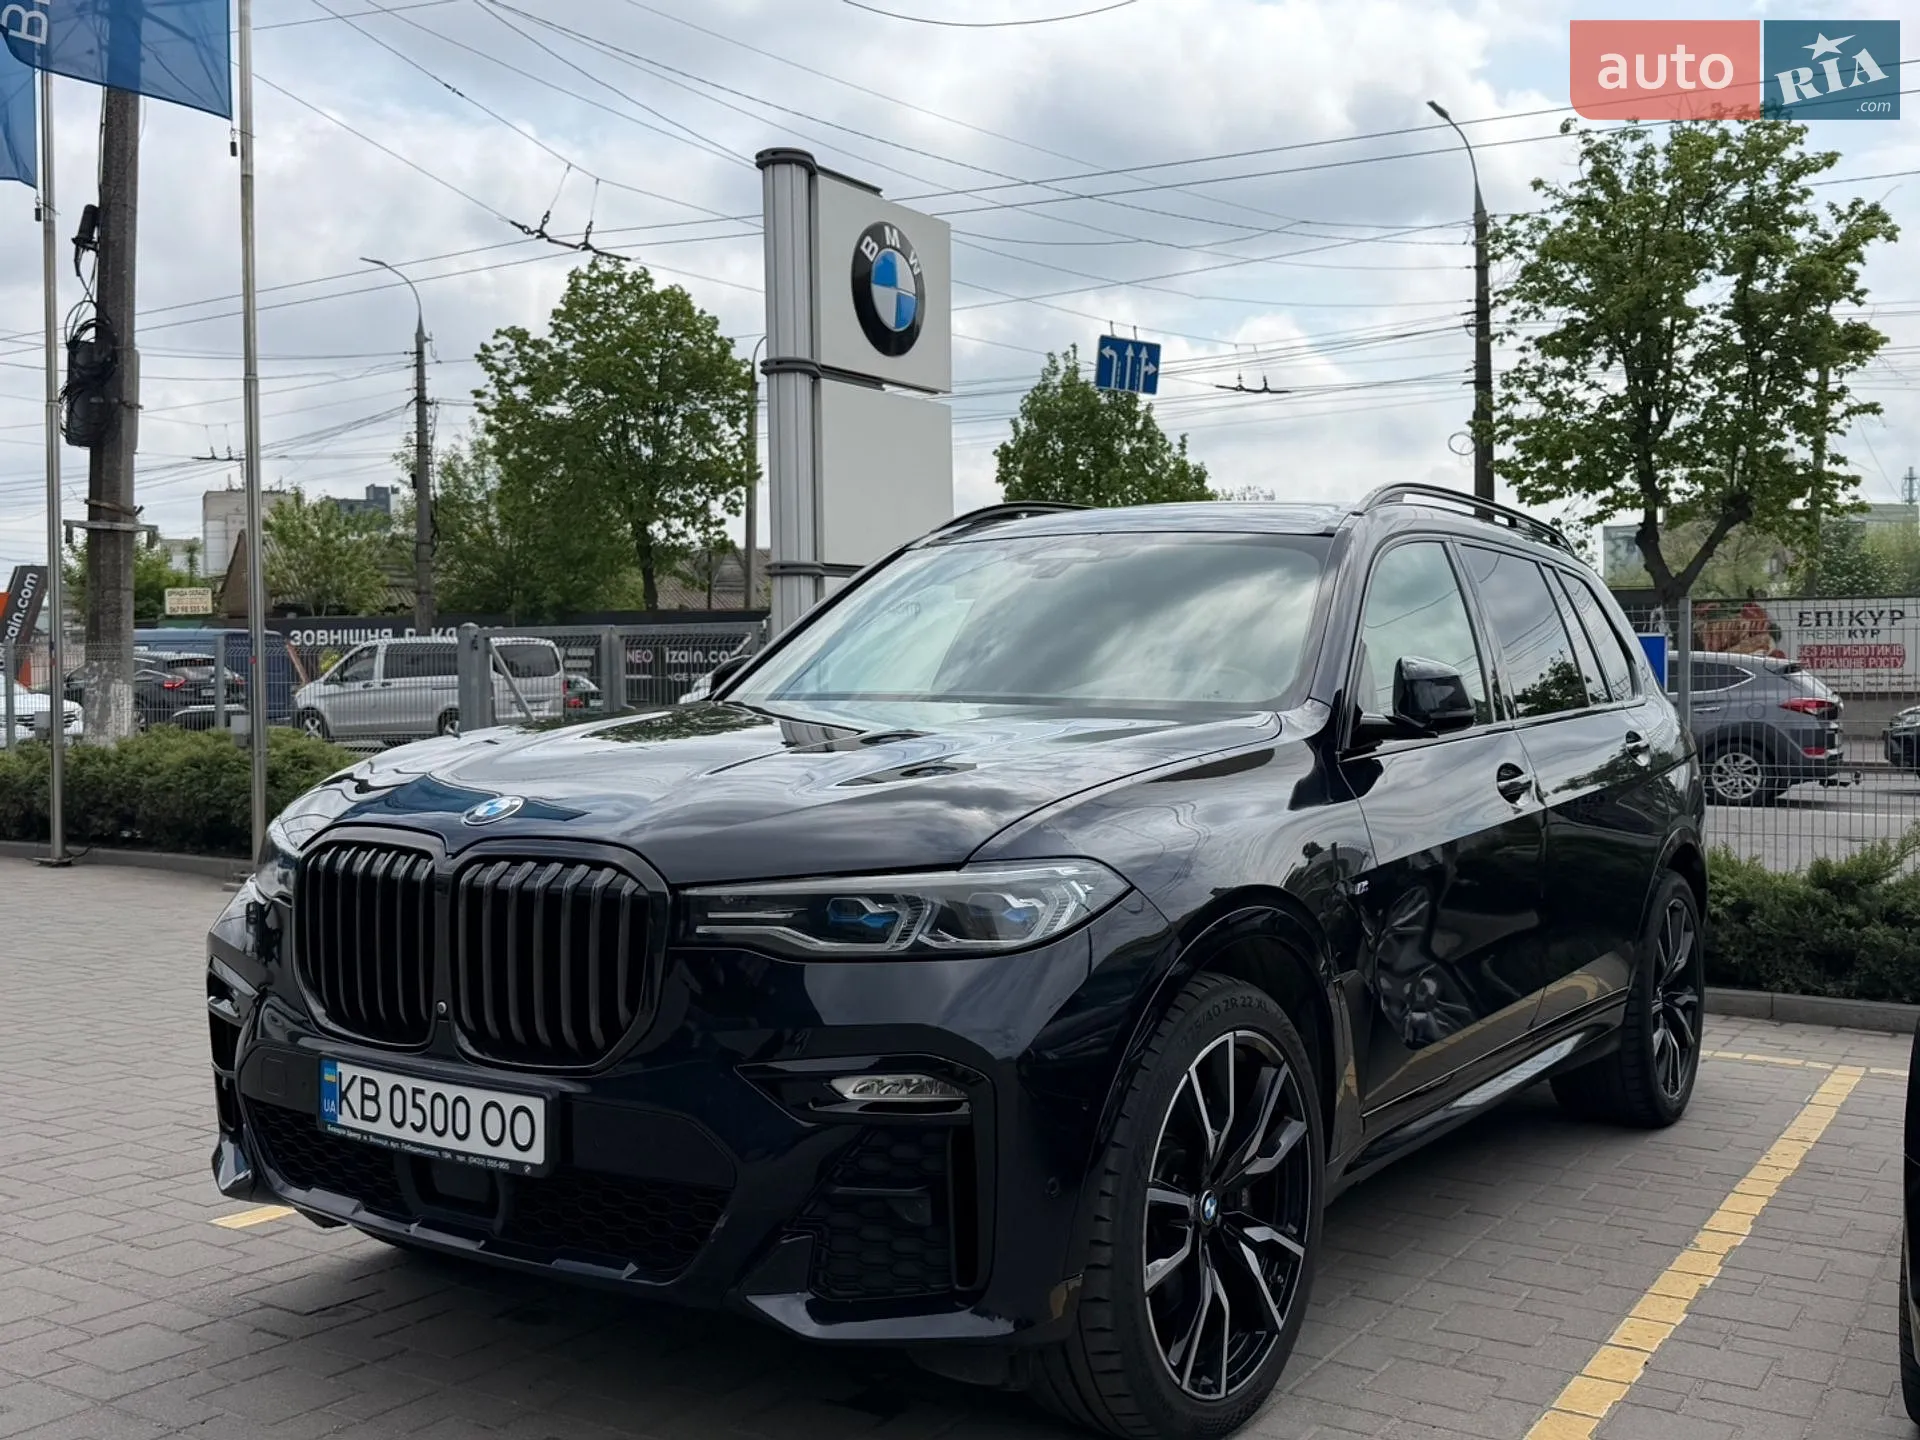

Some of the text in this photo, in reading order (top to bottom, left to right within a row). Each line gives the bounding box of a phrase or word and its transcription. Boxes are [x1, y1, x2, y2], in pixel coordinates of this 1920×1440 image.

[1, 0, 50, 45] B
[860, 225, 922, 276] BMW
[1798, 609, 1905, 628] ЕПІКУР
[1797, 628, 1881, 640] FRESH КУР
[626, 649, 653, 663] NEO
[1240, 996, 1254, 1008] 22
[323, 1098, 336, 1114] UA
[338, 1071, 381, 1124] KB
[389, 1083, 471, 1142] 0500
